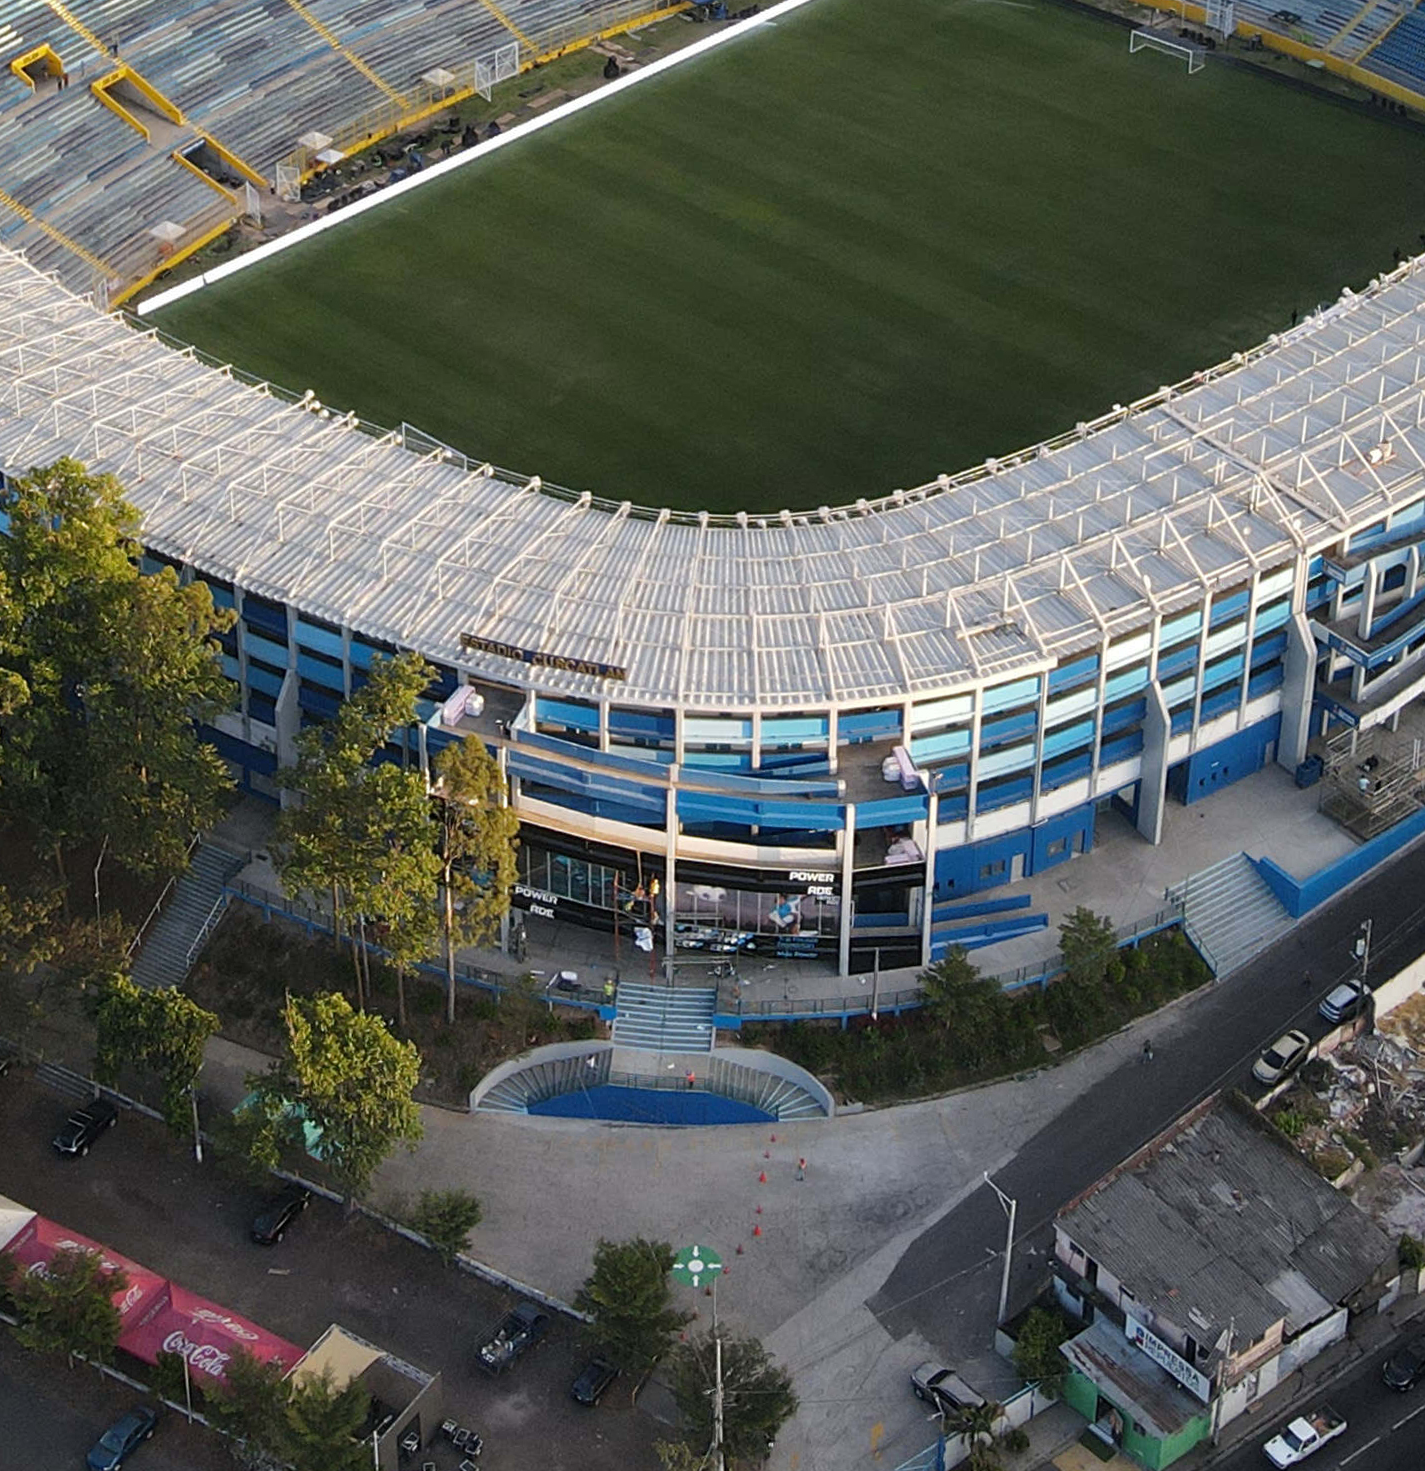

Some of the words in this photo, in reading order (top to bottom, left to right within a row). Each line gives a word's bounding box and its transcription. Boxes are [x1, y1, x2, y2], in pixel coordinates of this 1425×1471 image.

[460, 635, 524, 661] ESTADIO
[789, 871, 834, 883] POWER
[514, 886, 559, 905] POWER
